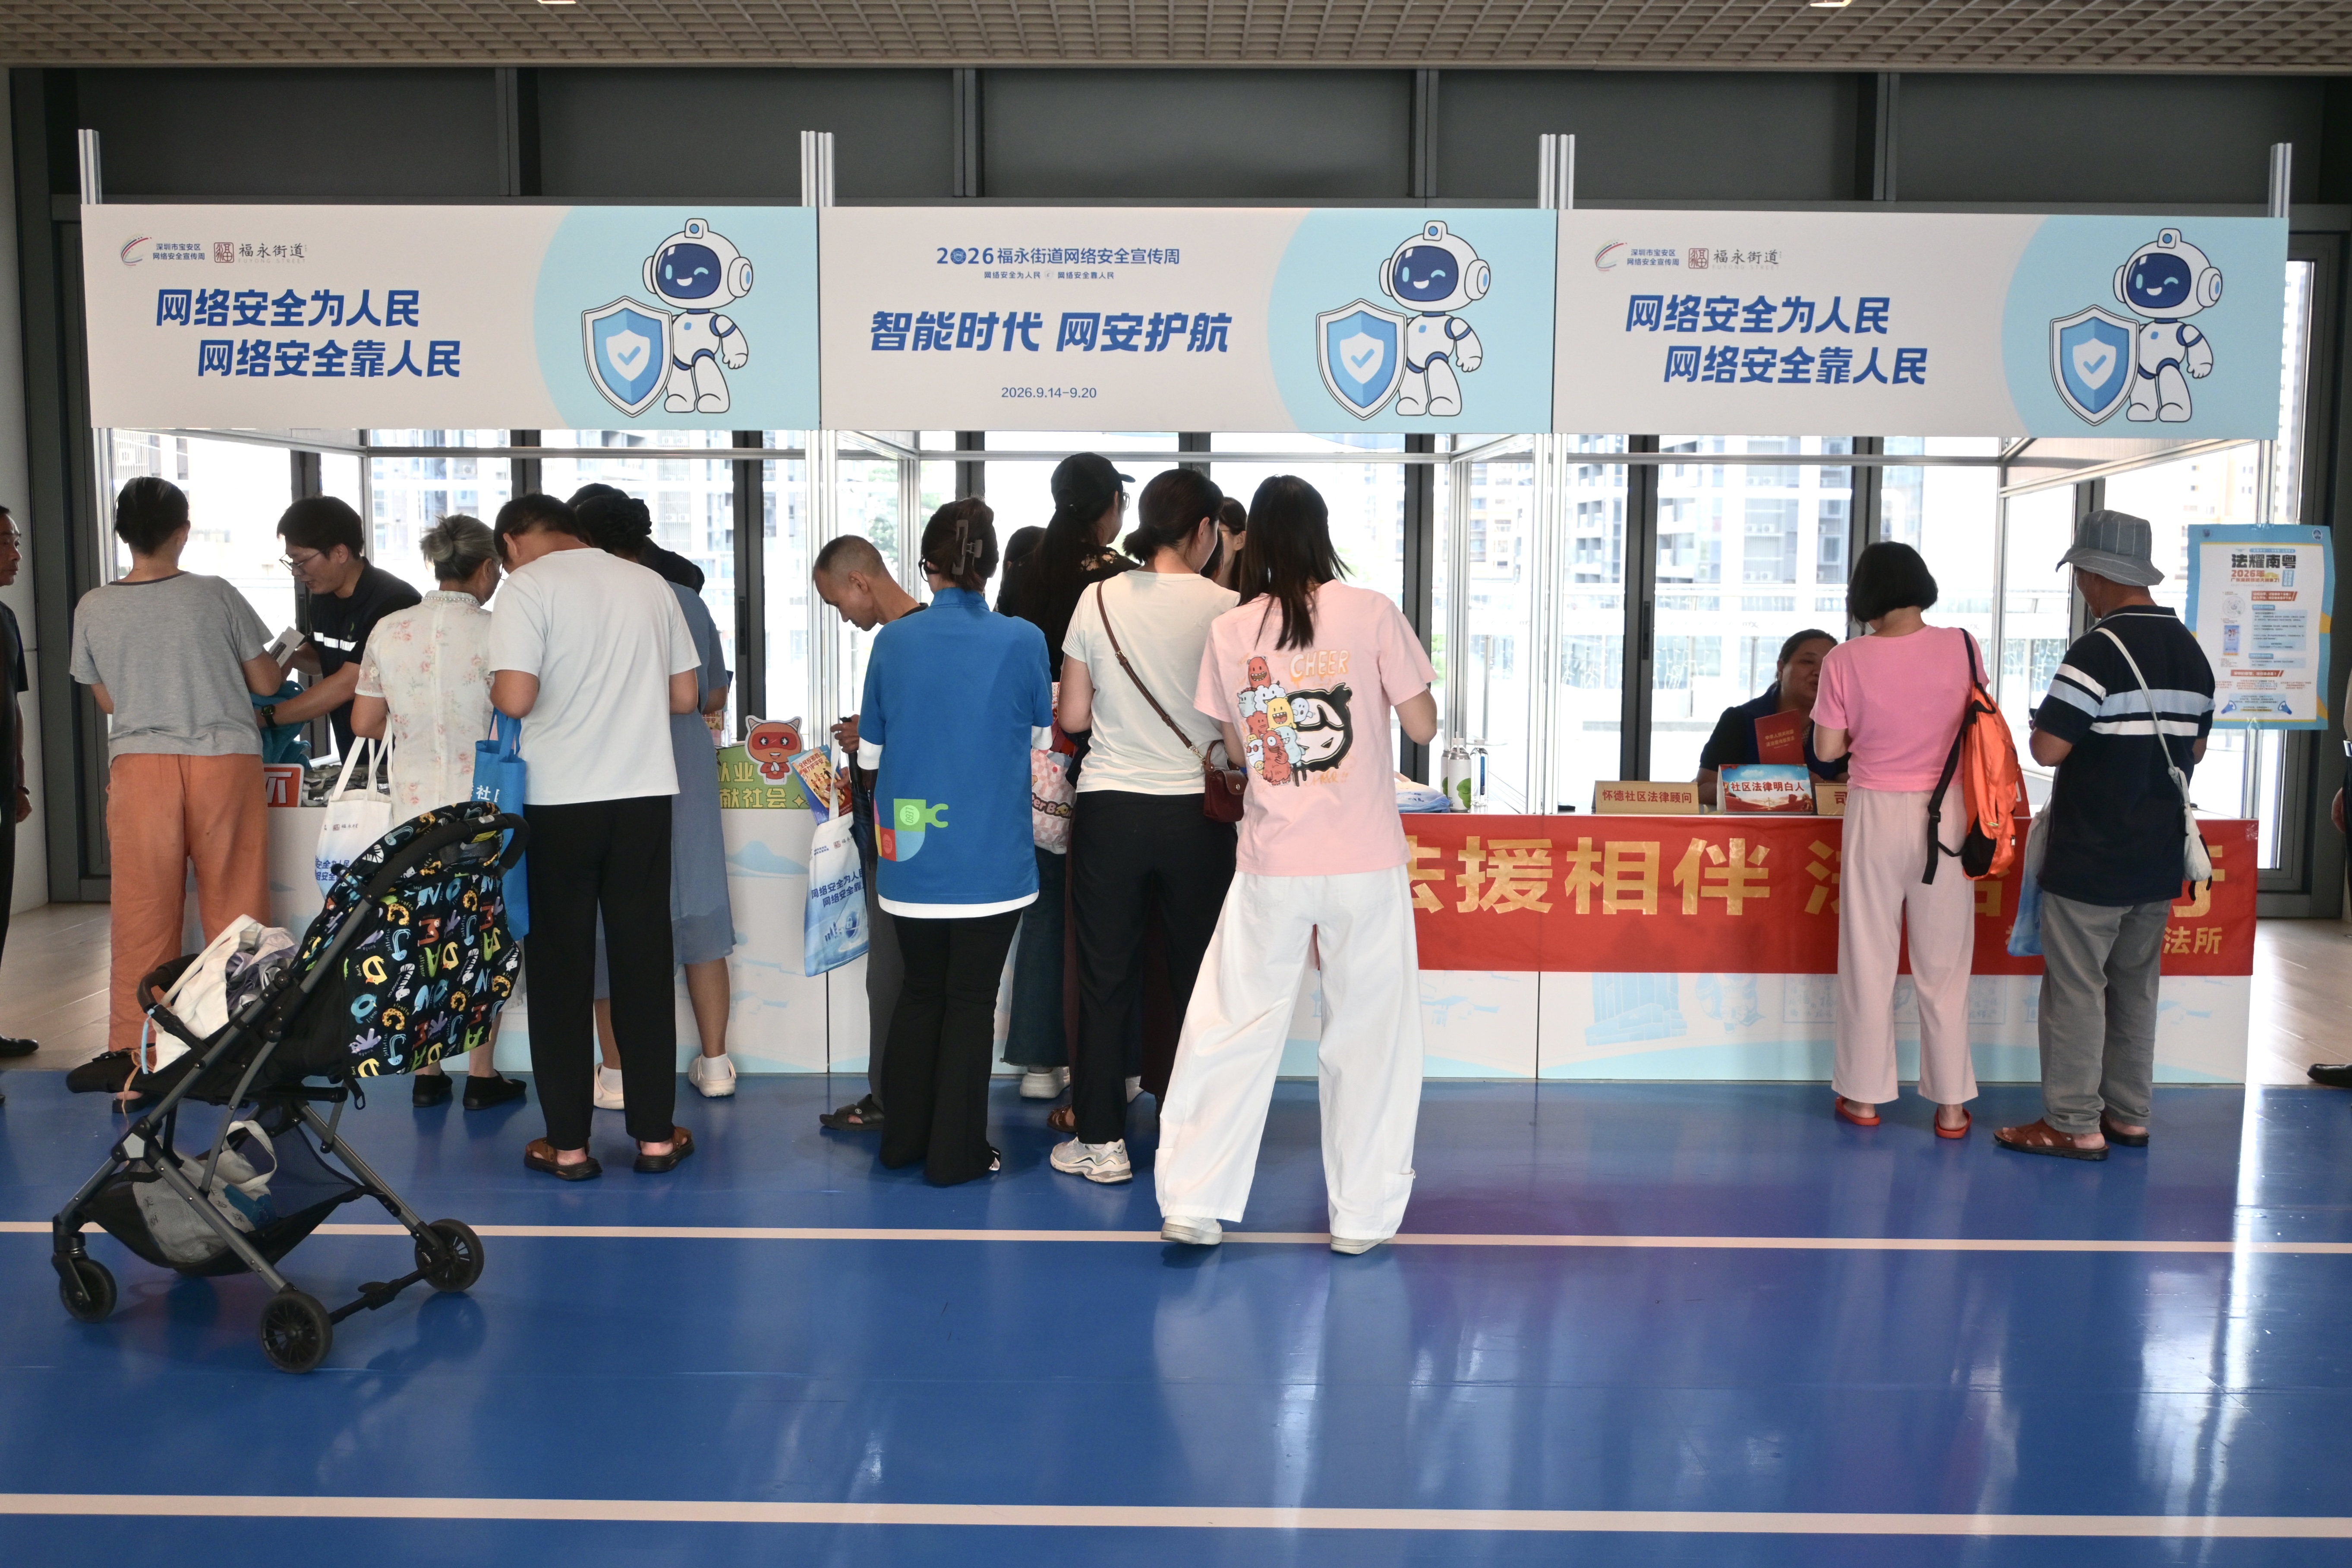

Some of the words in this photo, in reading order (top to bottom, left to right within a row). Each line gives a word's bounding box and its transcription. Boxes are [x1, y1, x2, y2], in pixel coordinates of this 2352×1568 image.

[239, 243, 305, 258] 福永街道
[1714, 249, 1780, 264] 福永街道
[1058, 271, 1114, 279] 网络安全靠人民
[156, 289, 419, 327] 网络安全为人民
[1626, 294, 1890, 334] 网络安全为人民
[871, 311, 1043, 352] 智能时代
[1056, 312, 1232, 353] 网安护航
[198, 339, 460, 377] 网络安全靠人民
[1664, 345, 1928, 385] 网络安全靠人民
[1001, 387, 1097, 398] 2026.9.14-9.20
[2232, 554, 2296, 568] 法耀南粤
[1290, 650, 1350, 678] CHEER
[1731, 782, 1804, 792] 社区法律明白人
[719, 788, 787, 808] 献社会
[1602, 789, 1692, 804] 怀德社区法律顾问
[1834, 792, 1848, 805] 司
[905, 807, 914, 823] LEGO
[823, 882, 864, 908] 网络安全靠
[393, 1003, 409, 1016] giraffe
